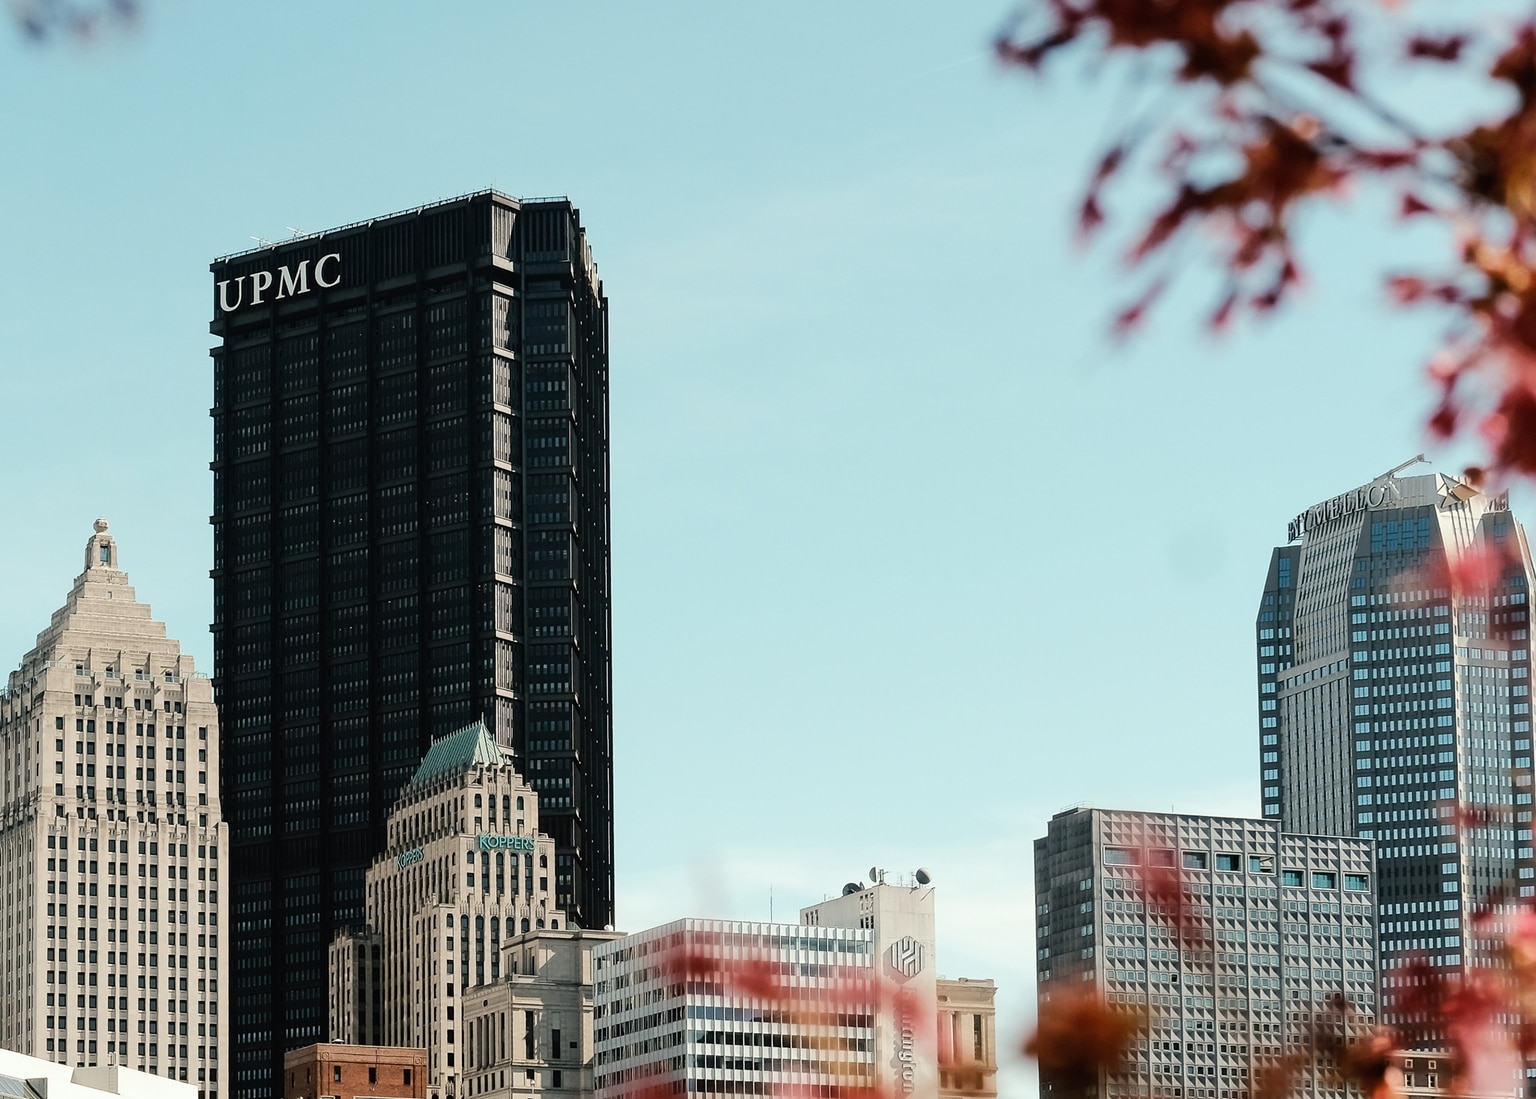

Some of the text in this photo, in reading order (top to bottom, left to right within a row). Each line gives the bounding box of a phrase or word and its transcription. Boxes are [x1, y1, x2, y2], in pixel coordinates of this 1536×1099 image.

[217, 253, 341, 312] UPMC
[1312, 480, 1402, 530] MELLON
[396, 848, 425, 870] KOPPERS
[478, 832, 537, 850] KOPPERS
[898, 987, 917, 1093] Hntington
